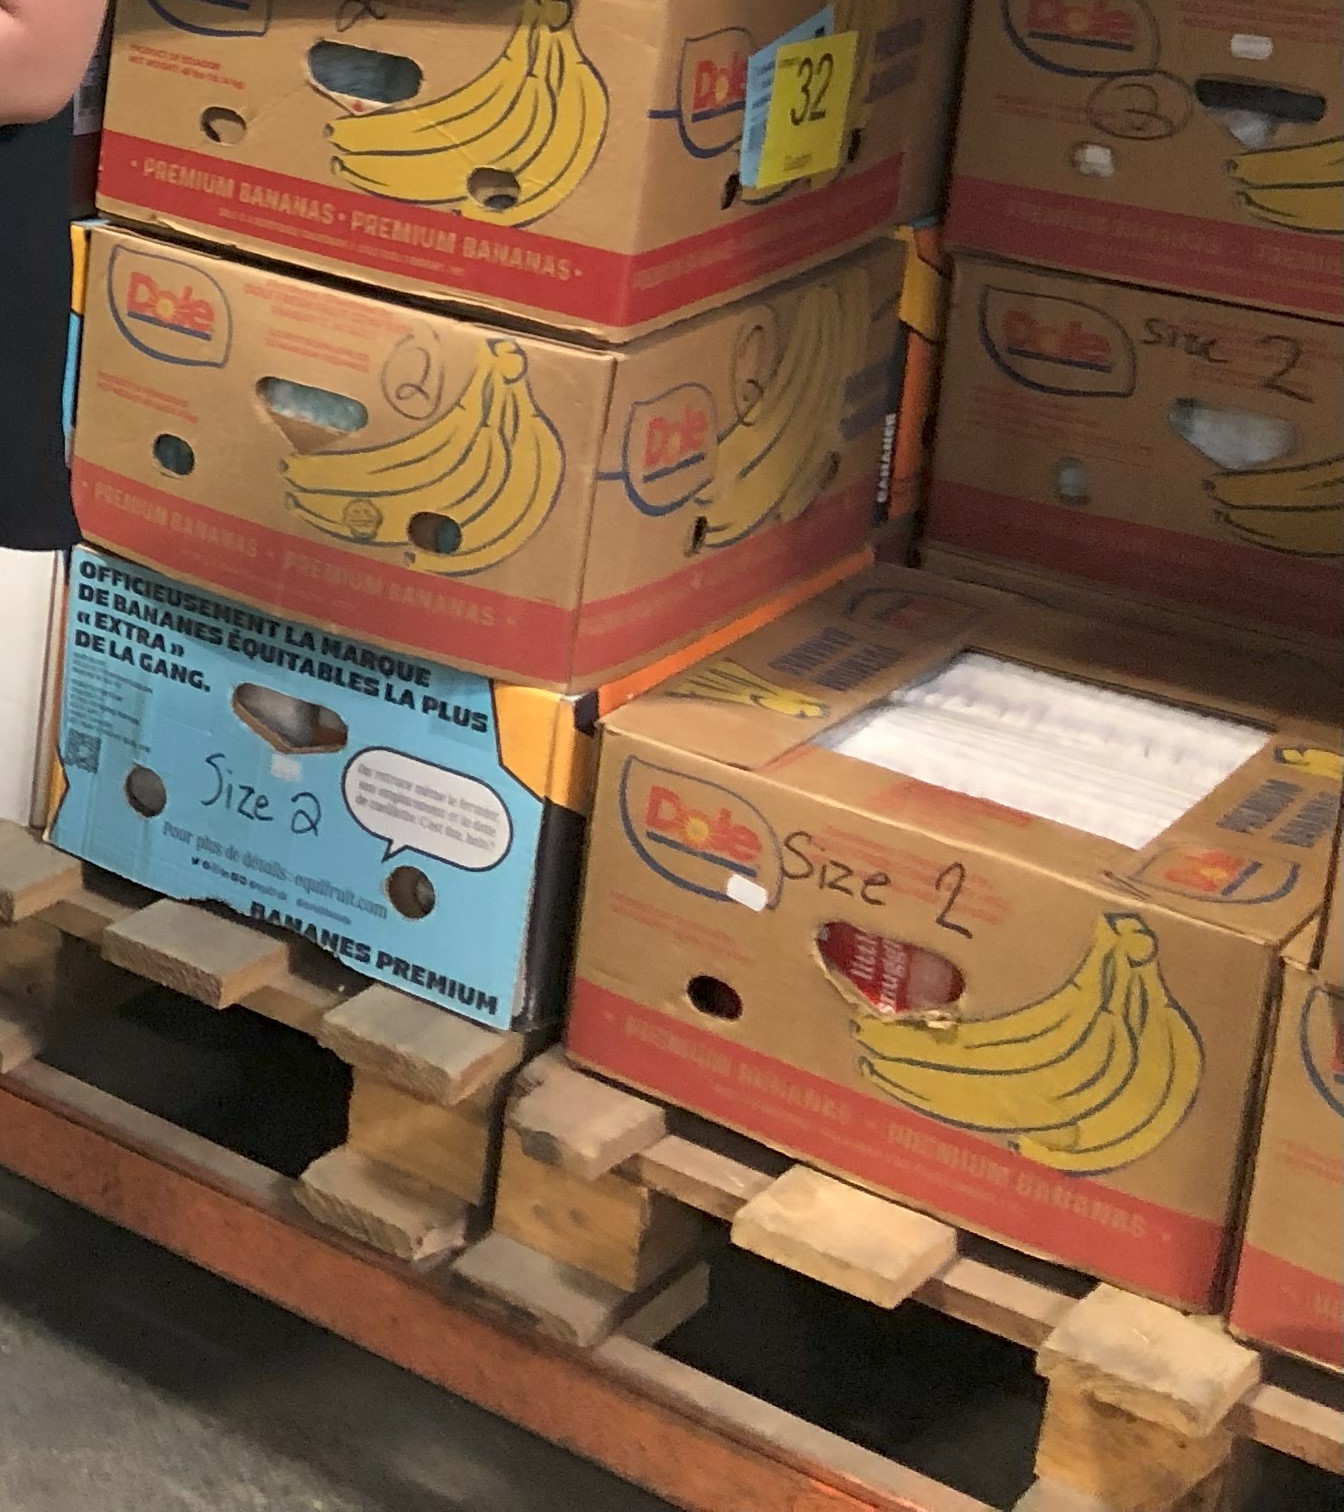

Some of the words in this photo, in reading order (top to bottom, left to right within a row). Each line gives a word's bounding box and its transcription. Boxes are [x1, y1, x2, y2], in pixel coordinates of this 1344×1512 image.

[692, 50, 748, 110] Dol
[790, 52, 834, 126] 32
[143, 158, 235, 199] PREMIUM
[238, 181, 335, 226] BANANAS
[350, 209, 456, 255] PREMIUM
[463, 237, 573, 282] BANANAS
[125, 270, 217, 334] Dole
[395, 346, 431, 403] 2
[1261, 335, 1314, 403] 2
[92, 479, 169, 526] PREMIUM
[169, 512, 258, 558] BANANAS
[283, 548, 385, 595] PREMIUM
[389, 578, 496, 627] BANANAS
[74, 628, 109, 656] DE
[110, 637, 137, 666] LA
[139, 648, 211, 693] GANG.
[78, 583, 109, 608] DE
[113, 594, 222, 646] BANANES
[227, 625, 380, 698] ÉQUITABLES
[384, 682, 415, 710] LA
[422, 694, 489, 734] PLUS
[79, 560, 280, 639] OFFICIEUSEMENT
[285, 626, 314, 651] LA
[321, 635, 432, 689] MARQUE
[201, 753, 274, 822] Size
[291, 791, 323, 837] 2
[644, 783, 764, 863] Dole
[163, 821, 191, 845] Pour
[196, 832, 223, 855] plus
[226, 843, 240, 861] de
[295, 871, 388, 920] equifruit.com
[782, 830, 891, 906] Size
[935, 861, 974, 939] 2
[250, 900, 372, 965] BANANES
[375, 949, 499, 1017] PREMIUM
